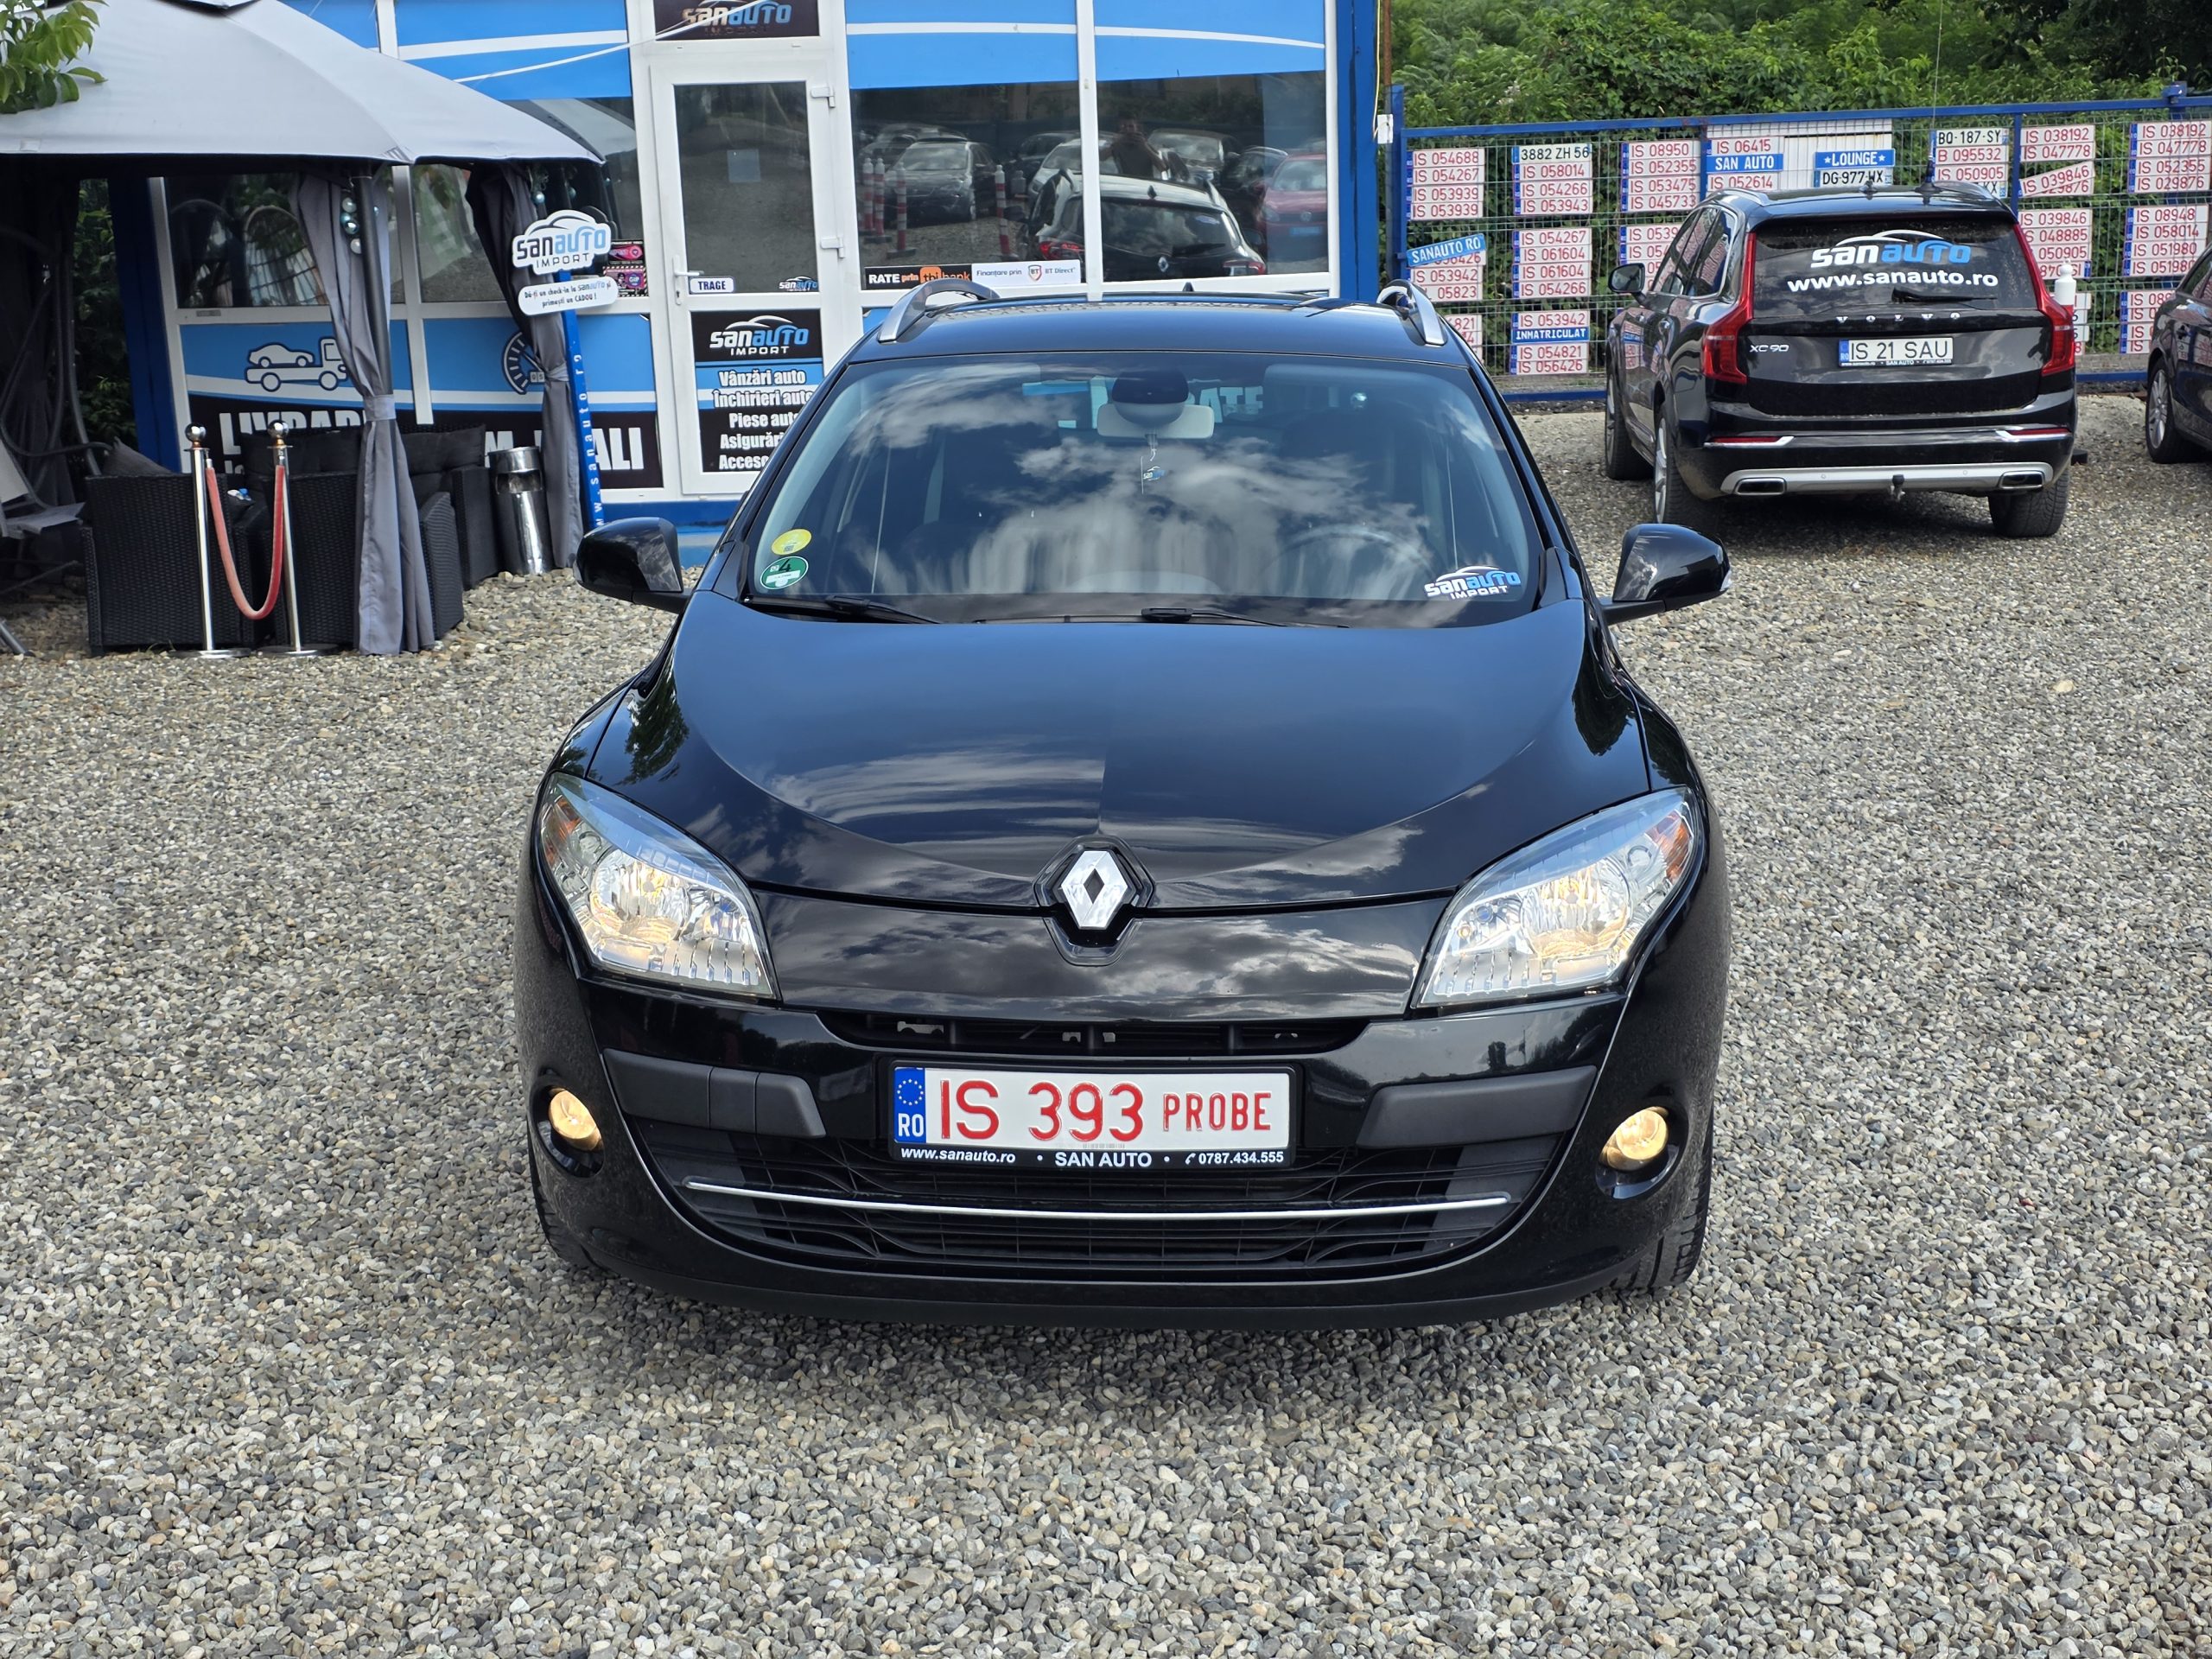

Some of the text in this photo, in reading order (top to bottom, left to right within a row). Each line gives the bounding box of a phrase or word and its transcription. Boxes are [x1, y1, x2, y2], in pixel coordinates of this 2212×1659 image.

[2026, 128, 2088, 143] IS 038192
[2143, 124, 2205, 138] IS 038192
[1522, 147, 1589, 160] 3882 ZH 56
[1632, 143, 1688, 157] IS 08950
[1717, 139, 1770, 154] IS 06415
[2024, 145, 2090, 159] IS 047778
[2140, 140, 2206, 155] IS 047778
[1415, 151, 1478, 166] IS 054688
[1833, 152, 1877, 166] LOUNGE
[1938, 148, 2001, 162] B 095532
[1631, 160, 1696, 174] IS 052355
[1715, 156, 1774, 170] SAN AUTO
[2139, 160, 2205, 174] IS 052355
[1415, 168, 1478, 182] IS 054267
[1524, 164, 1584, 178] IS 058014
[1939, 167, 2003, 181] IS 050905
[1631, 179, 1696, 193] IS 053475
[1711, 176, 1723, 189] IS
[2024, 165, 2088, 194] IS 039846
[2138, 176, 2203, 190] IS 029876
[1414, 188, 1478, 201] IS 053939
[1522, 183, 1587, 197] IS 054266
[1523, 200, 1588, 213] IS 053943
[1631, 195, 1696, 209] IS 045733
[1414, 204, 1478, 217] IS 053939
[2137, 208, 2195, 222] IS 08948
[2021, 212, 2086, 226] IS 039846
[1522, 231, 1586, 245] IS 054267
[1630, 227, 1678, 240] IS 0539
[2024, 229, 2087, 242] S 048885
[2137, 225, 2198, 238] IS 058014
[1412, 237, 1480, 264] SANAUTO RO
[1524, 247, 1584, 261] IS 061604
[1630, 246, 1641, 258] IS
[2039, 246, 2087, 259] 050905
[2134, 243, 2196, 257] IS 051980
[537, 253, 590, 268] IMPORT
[1523, 264, 1584, 278] IS 061604
[2133, 262, 2145, 274] IS
[869, 274, 900, 283] RATE
[1414, 269, 1478, 283] IS 053942
[1788, 270, 1998, 292] www.sanauto.ro
[698, 281, 726, 290] TRAGE
[1438, 286, 1476, 299] 05823
[1522, 282, 1586, 296] IS 054266
[2131, 294, 2143, 306] IS
[1521, 313, 1585, 327] IS 053942
[2131, 308, 2143, 320] IS
[1516, 328, 1586, 340] INMATRICULAT
[2132, 326, 2144, 338] IS
[731, 346, 789, 355] IMPORT
[1521, 346, 1580, 359] IS 054821
[1852, 340, 1948, 359] IS 21 SAU
[2131, 341, 2143, 352] IS
[1519, 359, 1582, 373] IS 056426
[719, 370, 805, 386] Vânzări auto
[713, 390, 780, 407] Închirieri
[729, 413, 798, 428] Piese aut
[719, 454, 769, 469] Acceso
[779, 559, 791, 572] 4
[1451, 586, 1507, 599] IMPORT
[941, 1079, 1271, 1141] IS 393 PROBE
[899, 1114, 924, 1136] RO
[901, 1148, 1284, 1167] www.sanauto.ro SAN AUTO 0787.434.555
